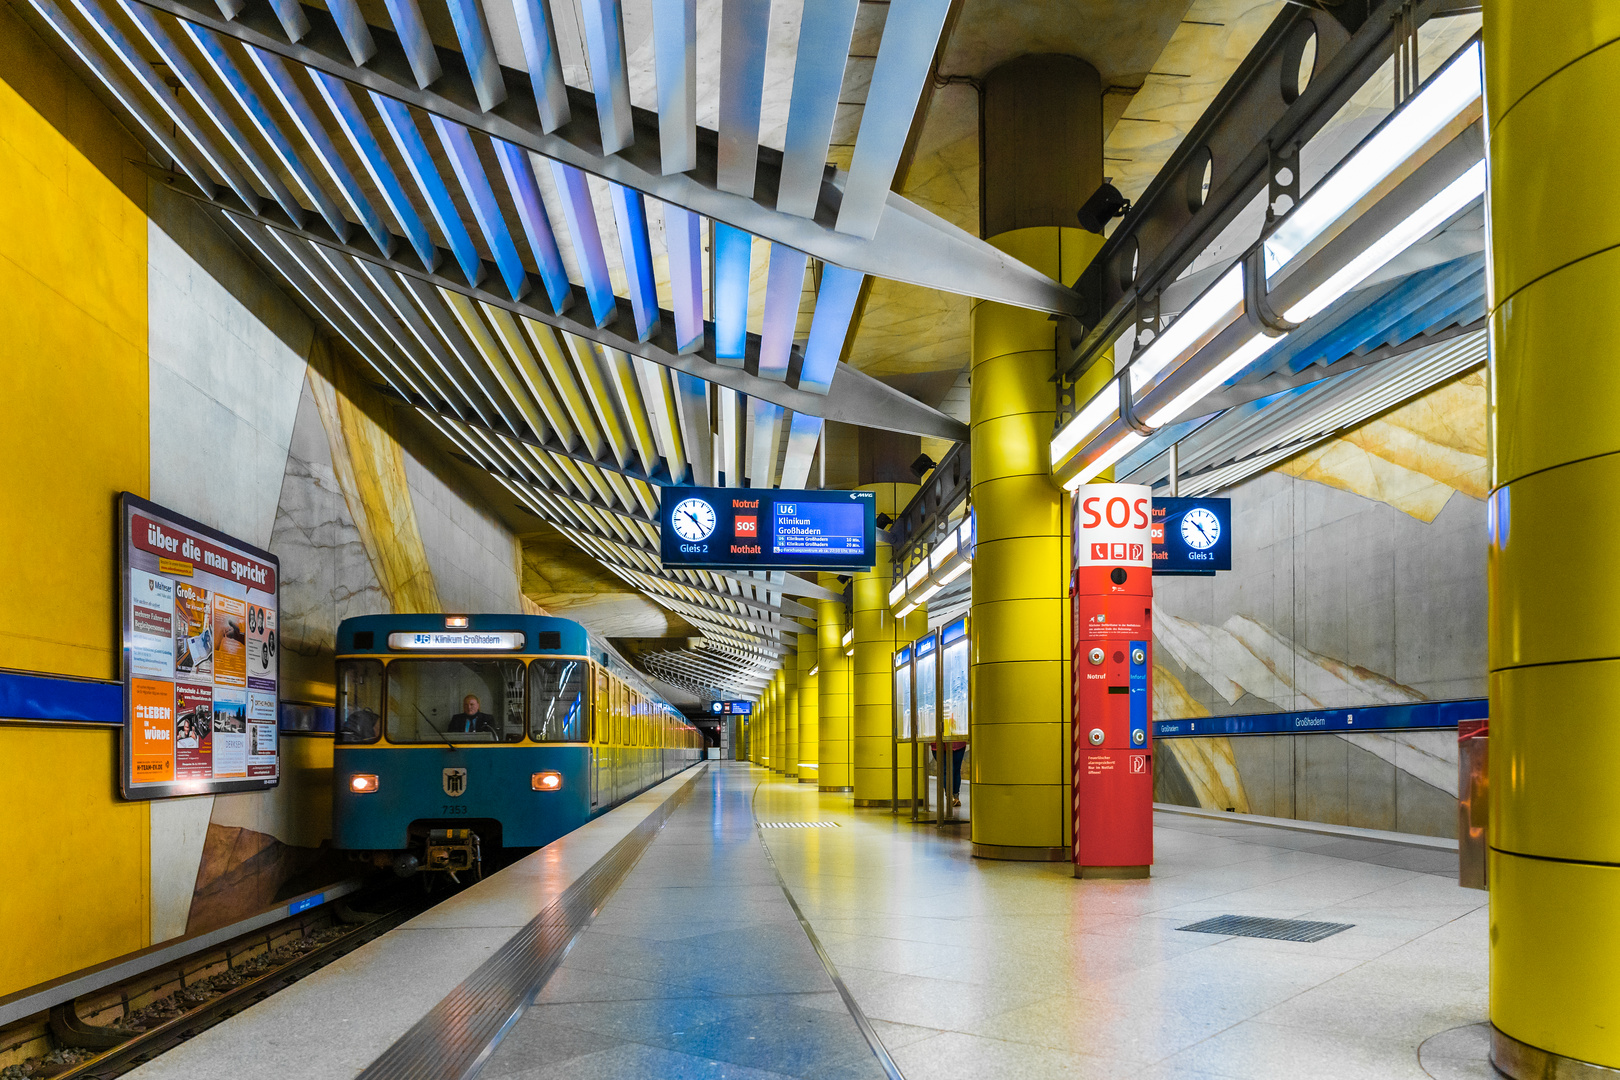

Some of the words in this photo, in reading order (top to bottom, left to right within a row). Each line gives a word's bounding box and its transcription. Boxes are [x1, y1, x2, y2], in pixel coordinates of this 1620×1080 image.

[732, 500, 759, 508] Notruf
[780, 506, 794, 514] U6
[1082, 497, 1148, 530] SOS
[1152, 508, 1166, 516] truf
[736, 522, 755, 530] SOS
[1152, 529, 1162, 538] OS
[148, 523, 178, 552] über
[182, 538, 200, 562] die
[204, 550, 228, 572] man
[680, 544, 702, 552] Gleis
[702, 544, 708, 552] 2
[730, 545, 761, 554] Nothalt
[1152, 551, 1168, 560] thalt
[155, 580, 172, 593] Malteser
[176, 585, 196, 601] Große
[435, 635, 462, 644] Klinikum
[464, 635, 500, 644] Großhadern
[177, 686, 195, 694] Fahrschule
[144, 706, 170, 719] LEBEN
[1296, 717, 1325, 726] Großhadern
[144, 726, 170, 740] WÜRDE
[442, 806, 468, 814] 7353
